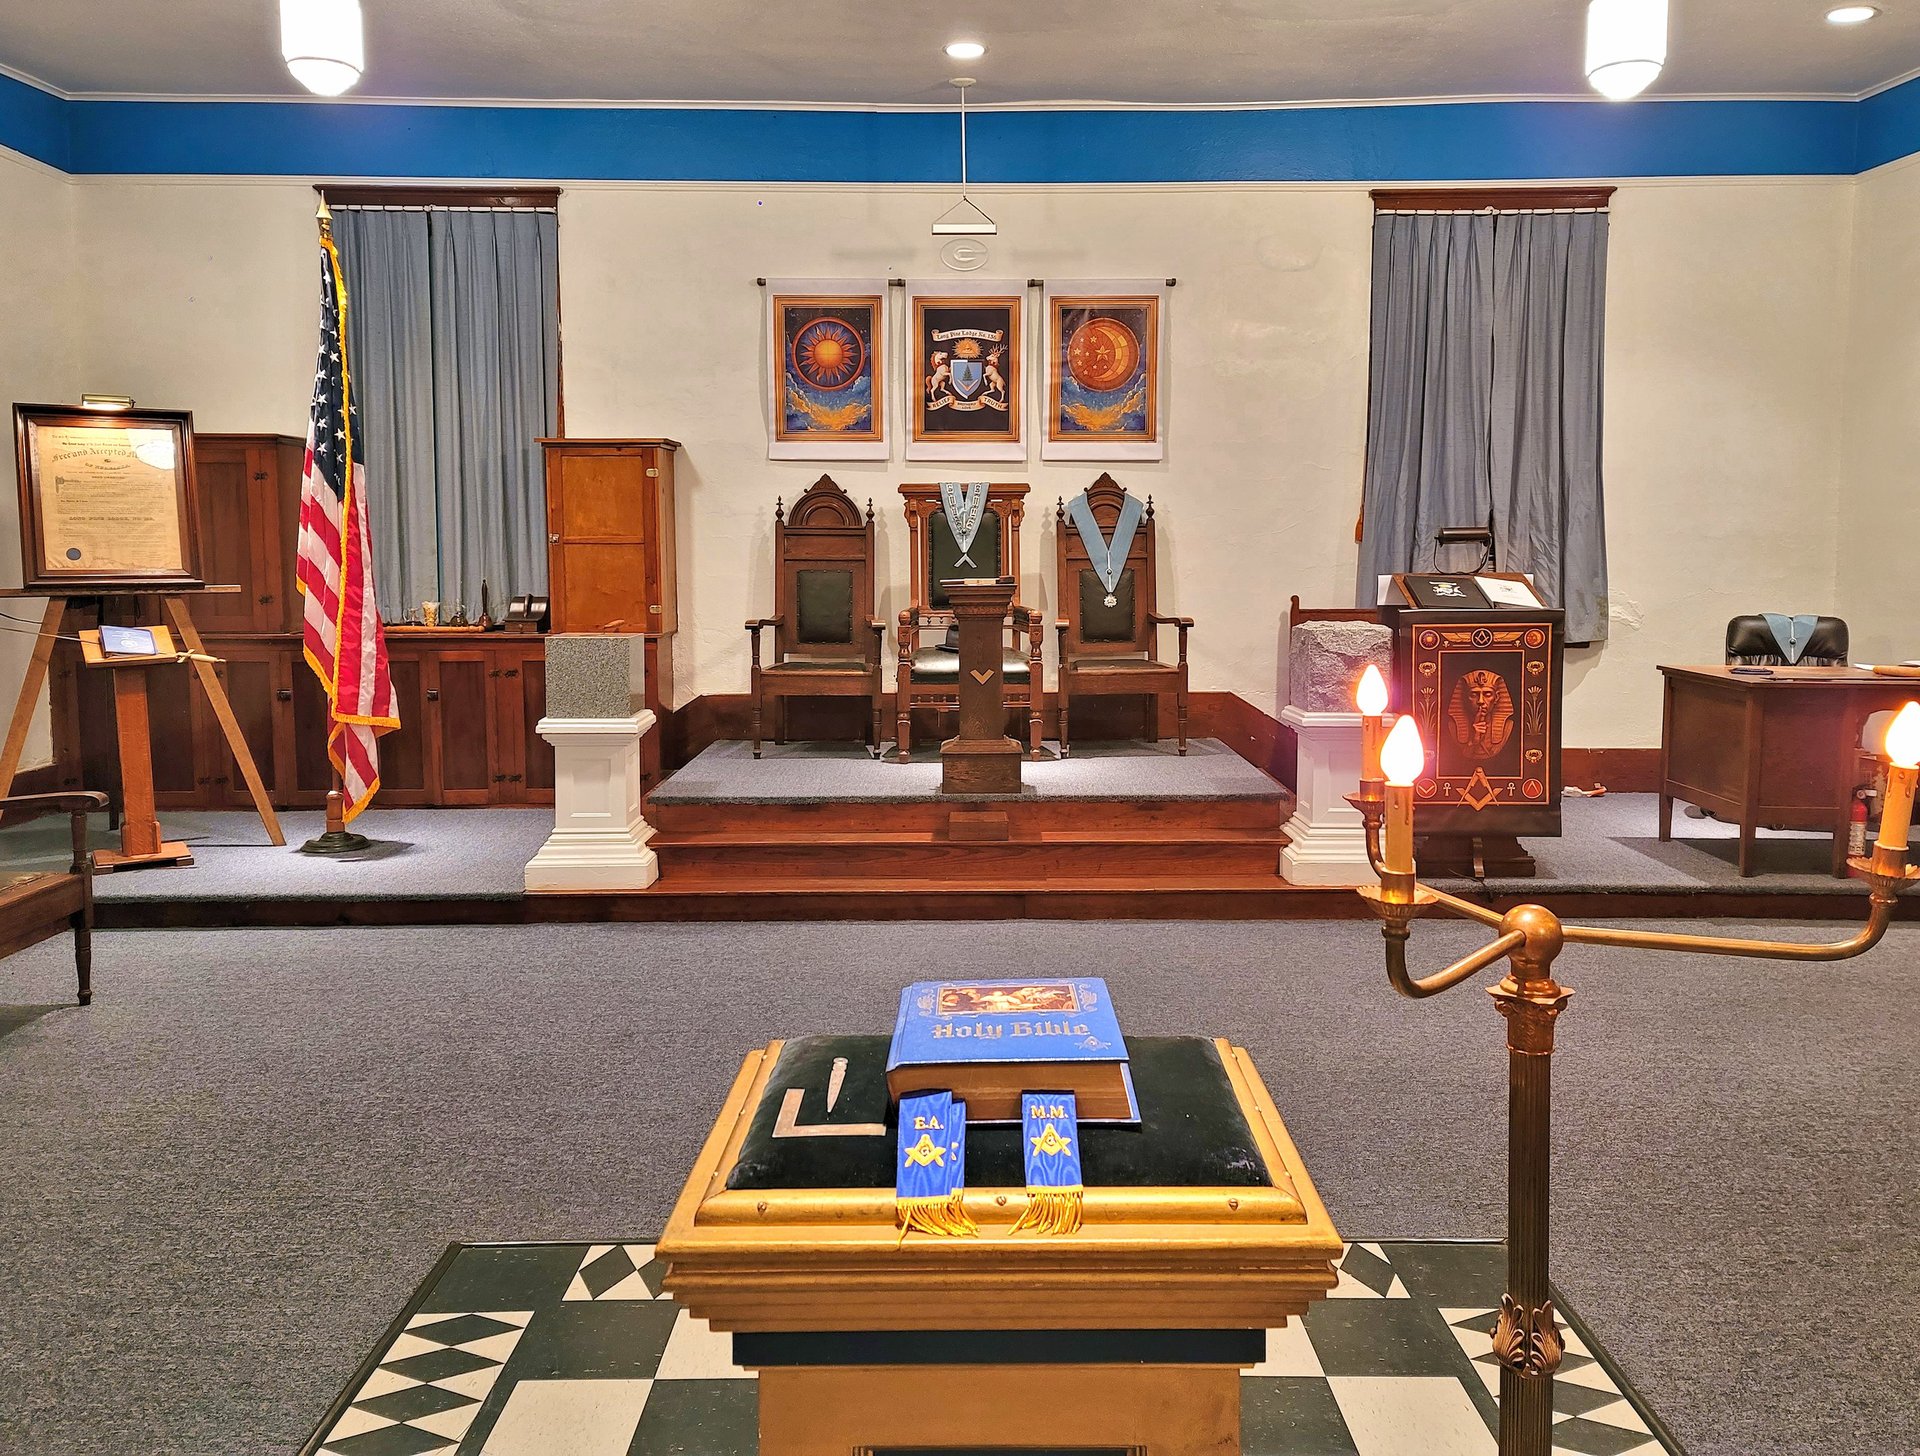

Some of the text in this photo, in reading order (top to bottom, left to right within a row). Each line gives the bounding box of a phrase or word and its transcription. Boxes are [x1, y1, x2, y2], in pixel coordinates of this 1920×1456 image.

[932, 397, 950, 408] RELIEF
[983, 397, 1003, 409] TRUTH
[72, 449, 88, 458] and
[90, 447, 127, 457] Accepted
[932, 1020, 1091, 1039] Holy Bible
[1030, 1104, 1069, 1119] M.M.
[913, 1115, 945, 1130] E.A.
